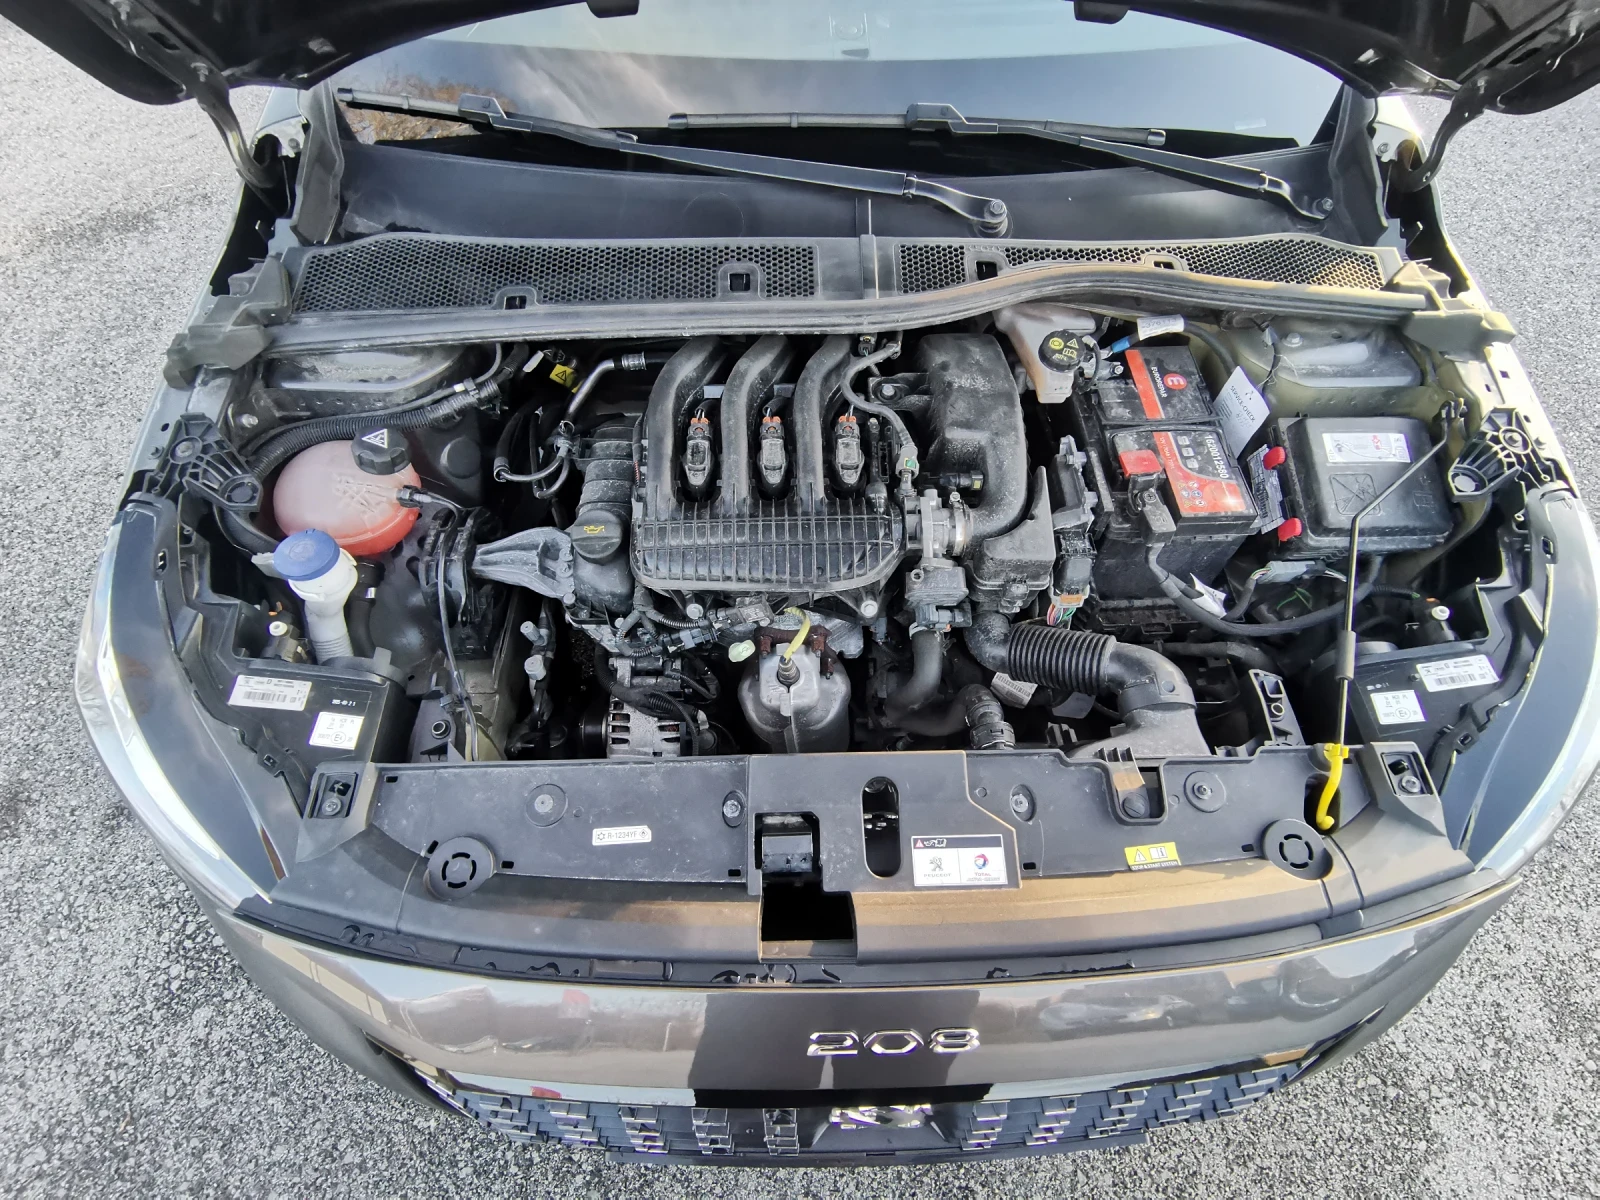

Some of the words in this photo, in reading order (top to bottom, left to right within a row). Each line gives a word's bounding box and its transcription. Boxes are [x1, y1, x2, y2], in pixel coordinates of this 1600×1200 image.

[1151, 366, 1168, 398] EUROREPAR
[1230, 385, 1256, 423] SERVICE-CHECK
[1204, 434, 1229, 479] 1620012580
[607, 830, 638, 839] R-1234YF
[806, 1027, 981, 1057] 208
